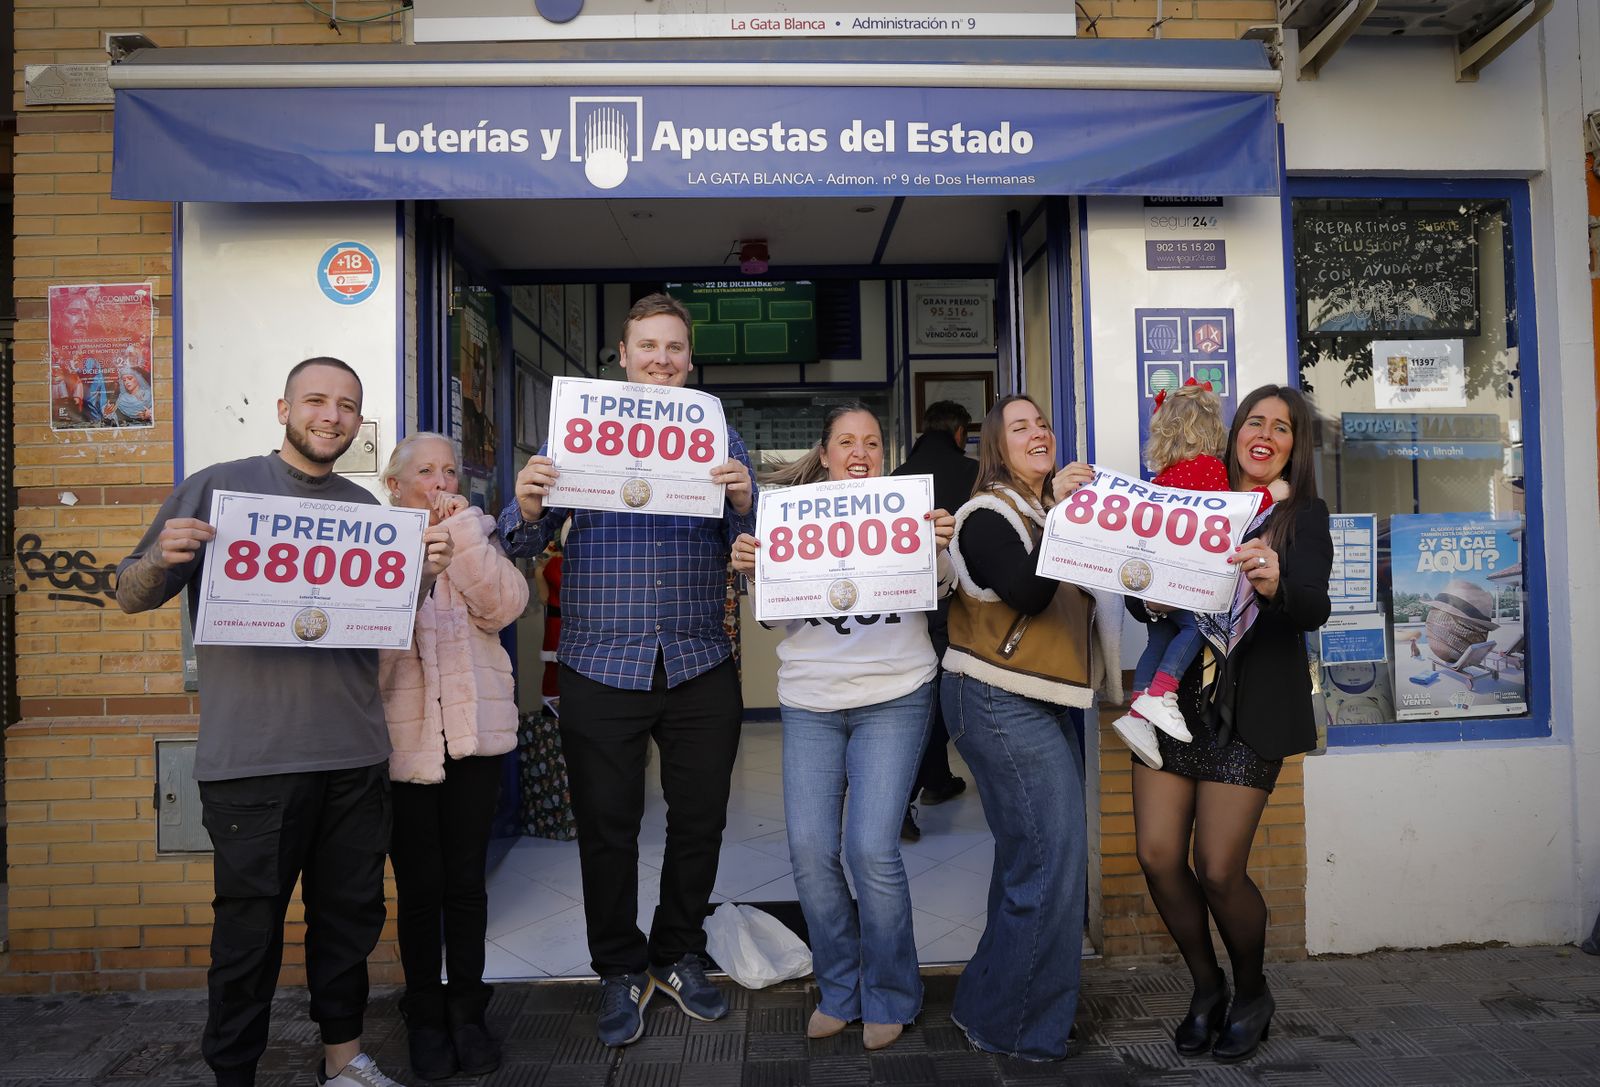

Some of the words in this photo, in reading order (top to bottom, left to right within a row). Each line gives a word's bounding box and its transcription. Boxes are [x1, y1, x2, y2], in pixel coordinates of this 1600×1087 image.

[731, 18, 745, 30] La
[750, 18, 780, 30] Gata
[784, 18, 826, 30] Blanca
[852, 17, 947, 30] Administración
[967, 18, 976, 30] 9
[374, 120, 529, 153] Loterías
[540, 128, 562, 161] y
[651, 120, 828, 159] Apuestas
[839, 119, 895, 153] del
[907, 121, 1034, 154] Estado
[688, 172, 707, 185] LA
[710, 172, 750, 185] GATA
[753, 172, 814, 185] BLANCA
[826, 172, 877, 185] Admon.
[901, 174, 910, 185] 9
[913, 173, 931, 185] de
[935, 174, 962, 185] Dos
[966, 173, 1035, 185] Hermanas
[1156, 243, 1174, 252] 902
[1177, 243, 1188, 252] 15
[1191, 243, 1201, 252] 15
[1203, 243, 1216, 252] 20
[337, 254, 362, 269] +18
[1318, 269, 1351, 282] CON
[1363, 263, 1411, 277] AYUDA
[949, 298, 980, 306] PREMIO
[1411, 358, 1435, 367] 11397
[622, 385, 653, 394] VENDIDO
[600, 395, 705, 424] PREMIO
[563, 418, 715, 463] 88008
[557, 486, 581, 494] LOTERÍA
[816, 483, 845, 492] VENDIDO
[1109, 476, 1227, 510] PREMIO
[299, 502, 336, 512] VENDIDO
[798, 492, 905, 520] PREMIO
[1064, 489, 1232, 554] 88008
[1334, 518, 1355, 528] BOTES
[271, 514, 398, 546] PREMIO
[769, 517, 921, 563] 88008
[1418, 538, 1438, 551] ¿Y
[1440, 537, 1457, 550] SI
[1460, 536, 1496, 550] CAE
[224, 539, 407, 590] 88008
[1052, 556, 1077, 566] LOTERÍA
[1084, 562, 1113, 574] NAVIDAD
[1168, 581, 1177, 589] 22
[1178, 584, 1215, 596] DICIEMBRE
[768, 595, 791, 603] LOTERÍA
[213, 619, 244, 628] LOTERÍA
[251, 620, 286, 628] NAVIDAD
[1401, 698, 1431, 706] VENTA
